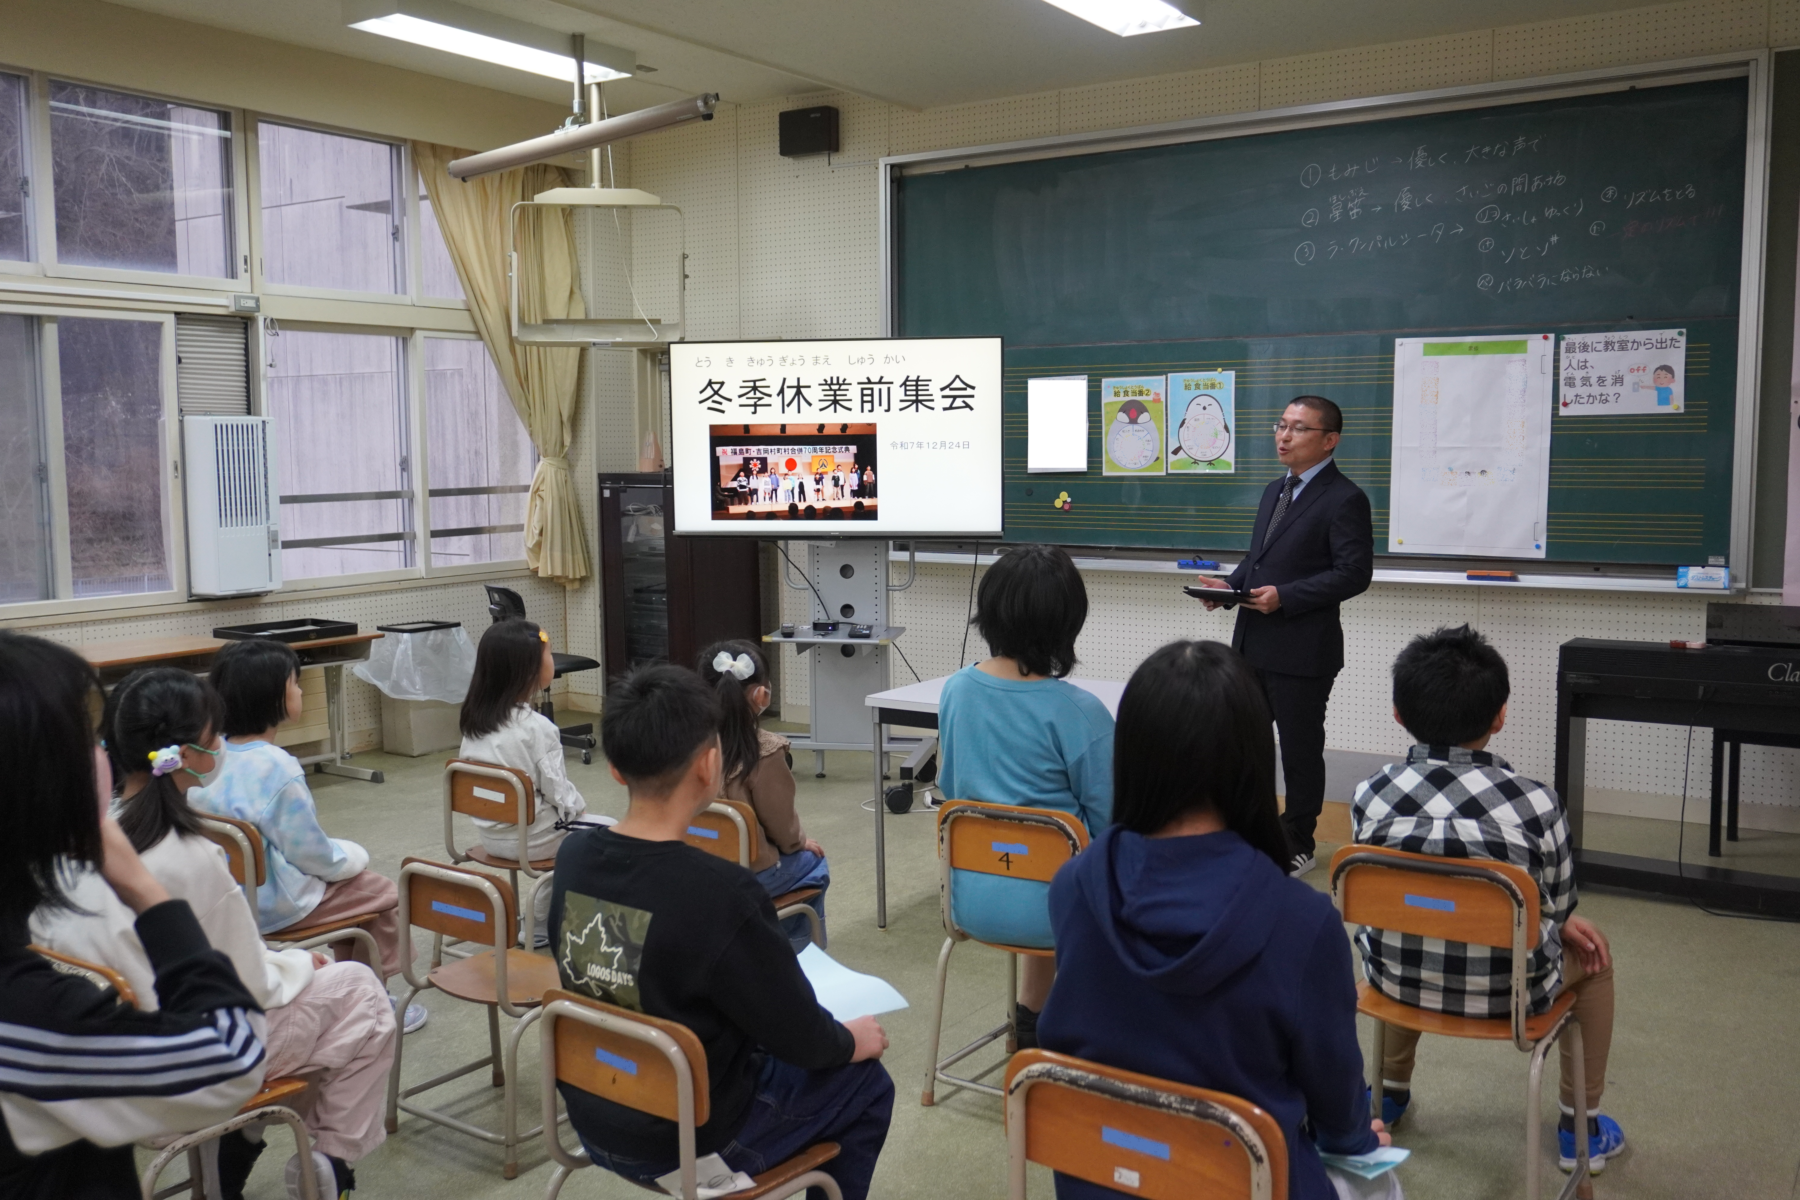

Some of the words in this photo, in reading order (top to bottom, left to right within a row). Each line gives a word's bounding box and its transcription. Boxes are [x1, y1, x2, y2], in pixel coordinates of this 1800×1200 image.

[1564, 337, 1681, 354] 最後に教室から出た
[694, 355, 713, 369] とう
[724, 354, 735, 368] き
[746, 354, 775, 368] きゅう
[778, 354, 806, 367] ぎょう
[811, 354, 832, 366] まえ
[848, 353, 875, 366] しゅう
[883, 353, 906, 366] かい
[1629, 366, 1647, 374] off
[697, 373, 977, 415] 冬季休業前集会
[889, 440, 971, 451] 令和7年12月24日
[997, 851, 1014, 871] 4
[587, 963, 611, 982] LOGOS
[611, 970, 634, 987] DAYS
